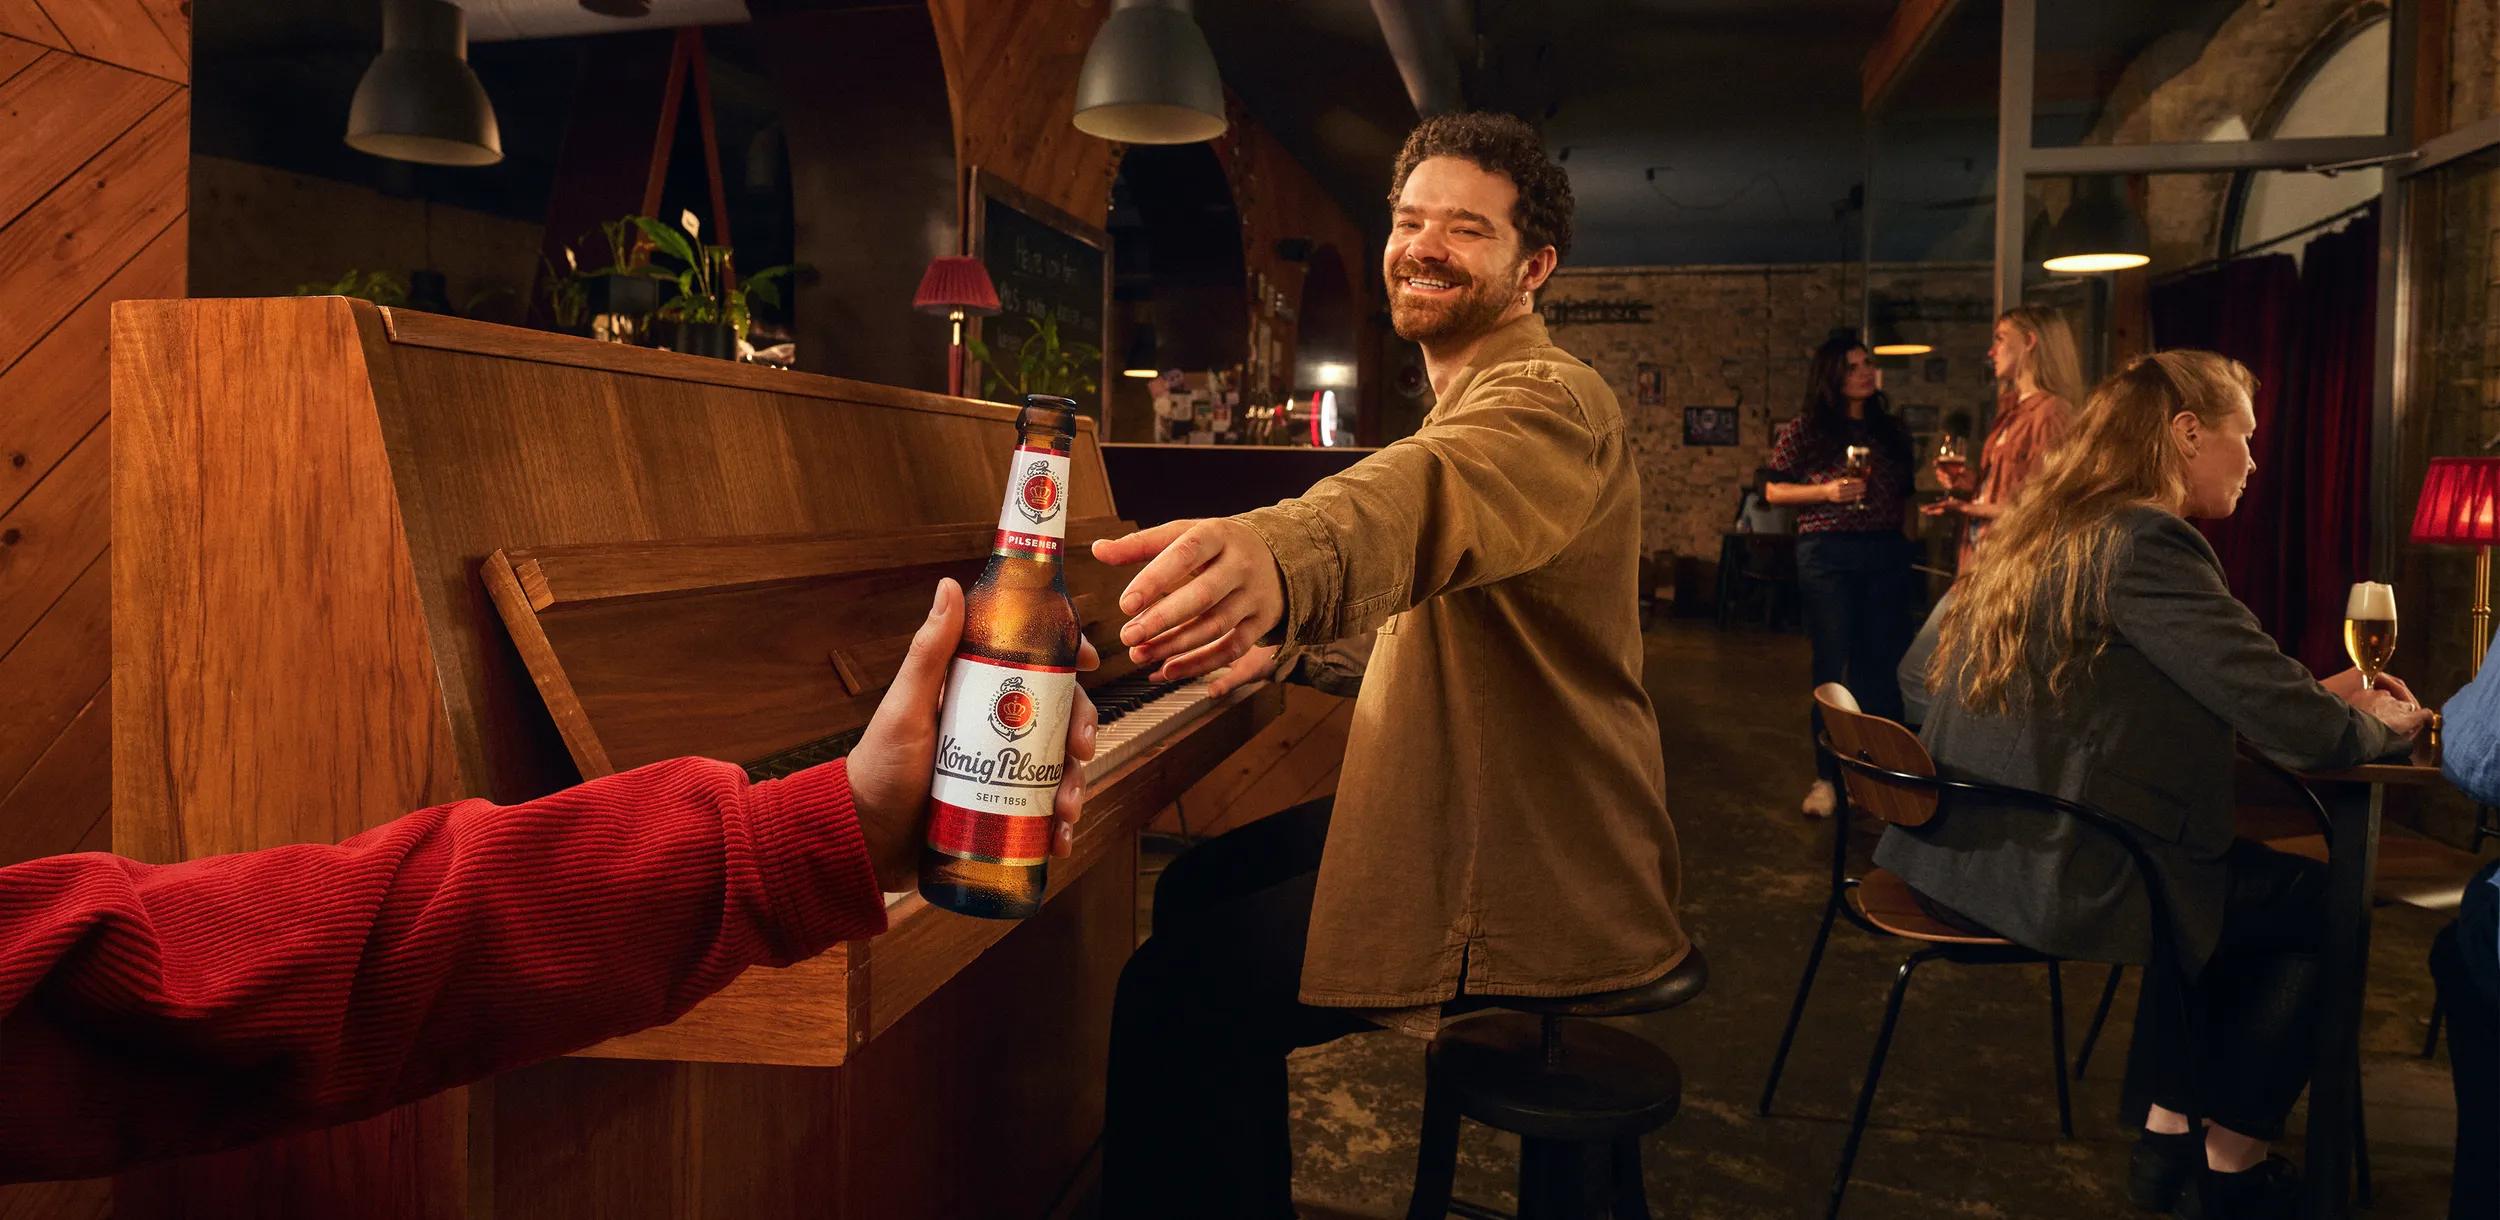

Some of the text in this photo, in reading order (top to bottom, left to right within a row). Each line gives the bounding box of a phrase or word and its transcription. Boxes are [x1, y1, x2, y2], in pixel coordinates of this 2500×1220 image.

[1008, 536, 1057, 549] PILSENER
[938, 734, 996, 784] König
[976, 792, 1027, 807] SEIT 1858
